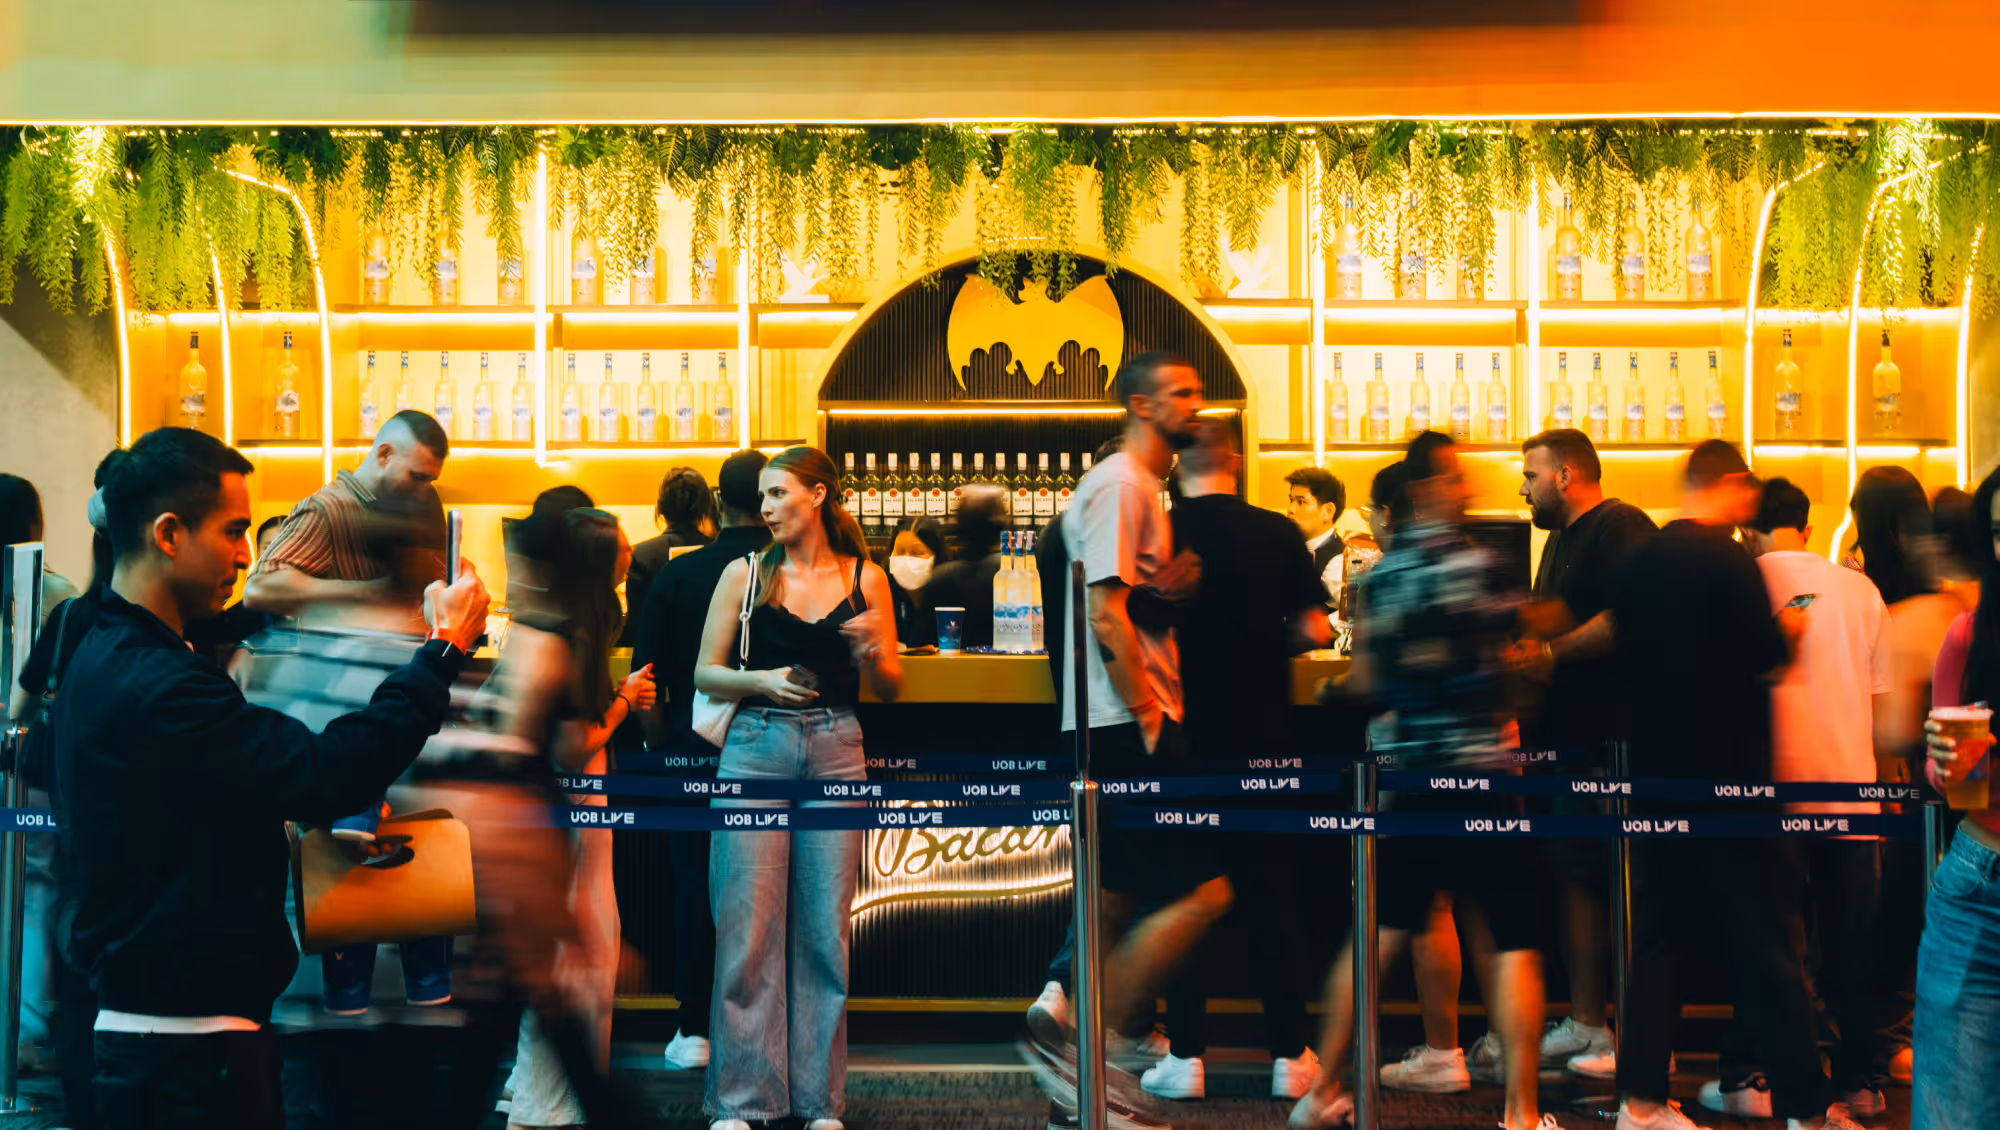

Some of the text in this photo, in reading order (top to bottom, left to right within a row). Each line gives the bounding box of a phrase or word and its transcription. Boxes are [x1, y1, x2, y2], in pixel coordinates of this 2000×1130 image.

[665, 756, 688, 767] UOB
[1529, 750, 1557, 762] LIVE
[888, 758, 916, 769] LIVE
[992, 760, 1046, 770] UOB LIVE
[1249, 758, 1302, 768] UOB LIVE
[572, 778, 603, 790] LIVE
[684, 782, 742, 794] UOB LIVE
[1102, 782, 1160, 794] UOB LIVE
[1241, 778, 1300, 790] UOB LIVE
[1430, 778, 1489, 790] UOB LIVE
[1572, 781, 1632, 794] UOB LIVE
[824, 785, 882, 796] UOB LIVE
[963, 785, 1020, 796] UOB LIVE
[1715, 785, 1775, 798] UOB LIVE
[1859, 787, 1920, 799] UOB LIVE
[16, 814, 44, 826] UOB
[570, 811, 635, 824] UOB LIVE
[725, 814, 789, 826] UOB LIVE
[878, 812, 943, 824] UOB LIVE
[1032, 809, 1060, 822] UOB
[1155, 812, 1220, 826] UOB LIVE
[1310, 816, 1375, 830] UOB LIVE
[1465, 819, 1531, 832] UOB LIVE
[1623, 820, 1689, 832] UOB LIVE
[1782, 819, 1849, 832] UOB LIVE
[875, 800, 1060, 877] Bacar
